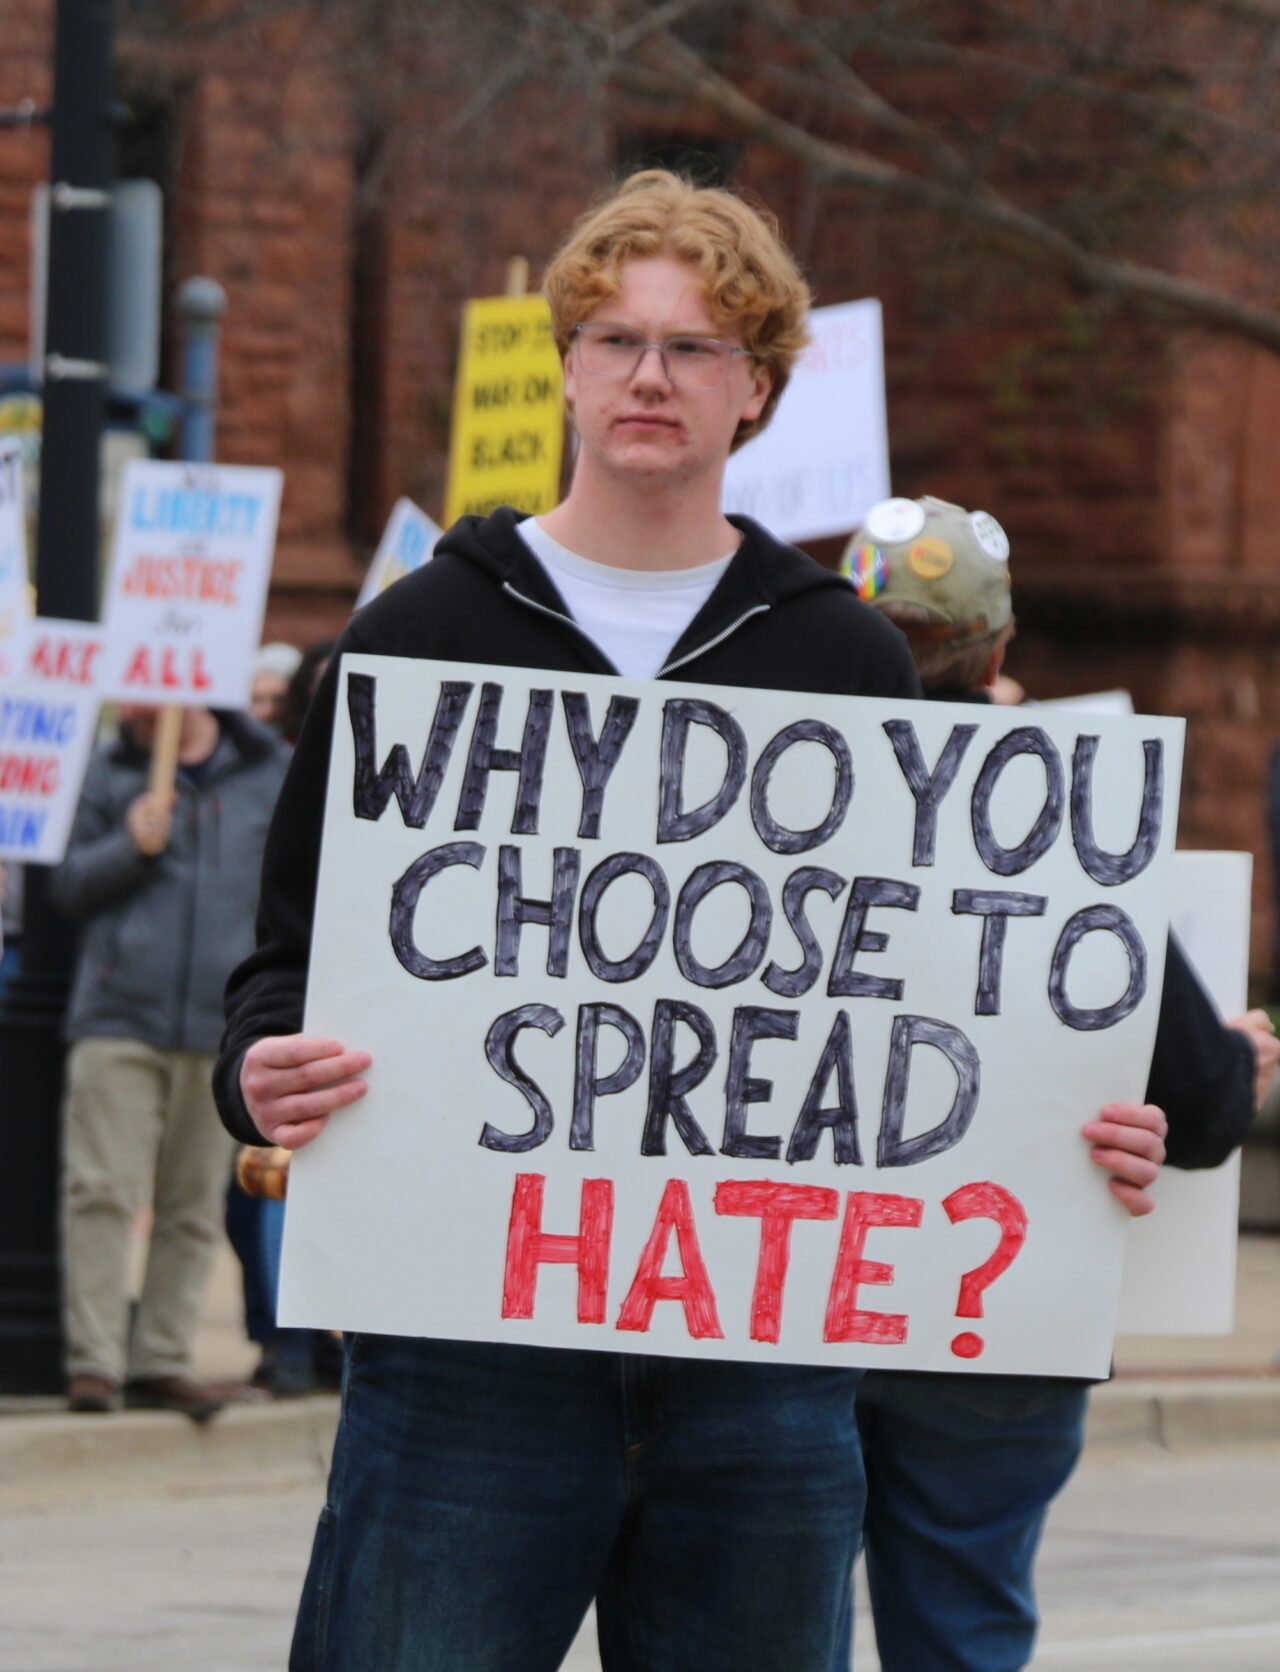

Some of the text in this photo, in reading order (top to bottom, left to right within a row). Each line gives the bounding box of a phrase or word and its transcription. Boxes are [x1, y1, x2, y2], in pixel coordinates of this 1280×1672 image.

[130, 483, 261, 535] LIBERTY
[122, 553, 246, 608] JUSTICE
[30, 636, 102, 687] AKE
[122, 643, 212, 691] ALL
[347, 672, 1161, 887] WHY DO YOU
[389, 842, 1144, 1031] CHOOSE TO
[478, 999, 982, 1168] SPREAD
[501, 1173, 1028, 1359] HATE?
